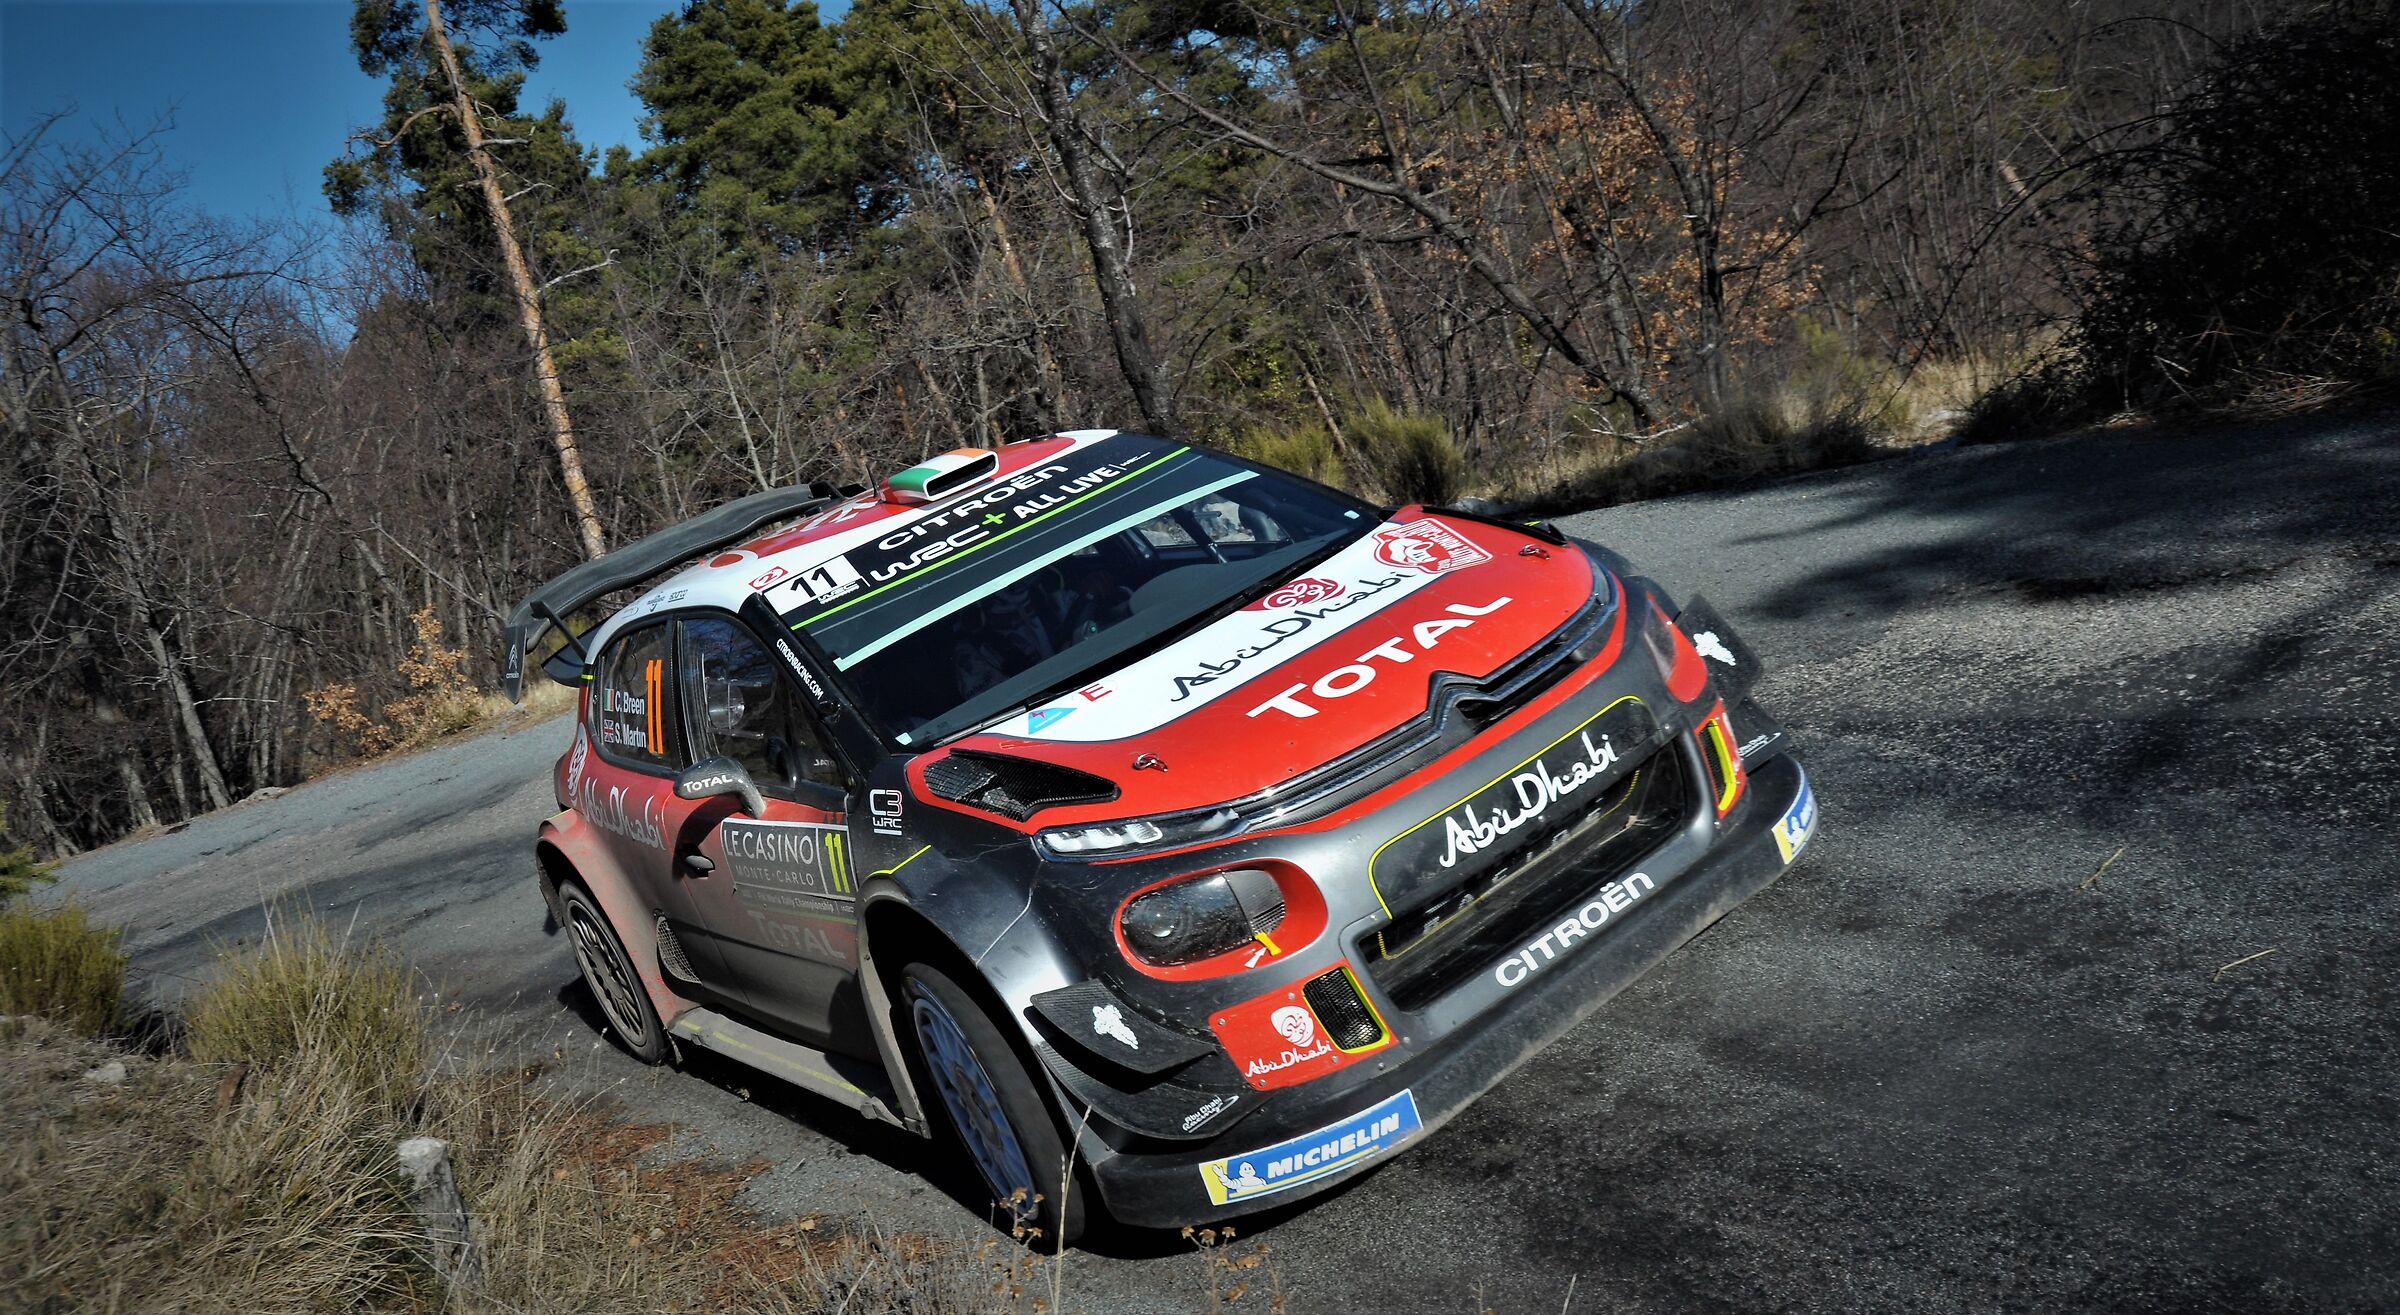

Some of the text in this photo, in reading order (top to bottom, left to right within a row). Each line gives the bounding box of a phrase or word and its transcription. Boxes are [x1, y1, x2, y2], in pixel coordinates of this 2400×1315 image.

[1012, 490, 1066, 520] ALL
[1060, 466, 1120, 494] LIVE
[790, 566, 838, 598] 11
[776, 638, 824, 700] CITROENRACING.COM
[1245, 595, 1513, 718] TOTAL
[615, 690, 645, 715] C. Breen
[646, 659, 664, 754] 11
[1078, 683, 1113, 702] E
[615, 722, 647, 748] S. Martin
[683, 774, 734, 793] TOTAL
[869, 789, 903, 816] C3
[872, 816, 902, 829] WRC
[724, 830, 850, 894] LE CASINO 11
[1184, 1094, 1222, 1124] Abu Dhabi
[1267, 1112, 1399, 1179] MICHELIN
